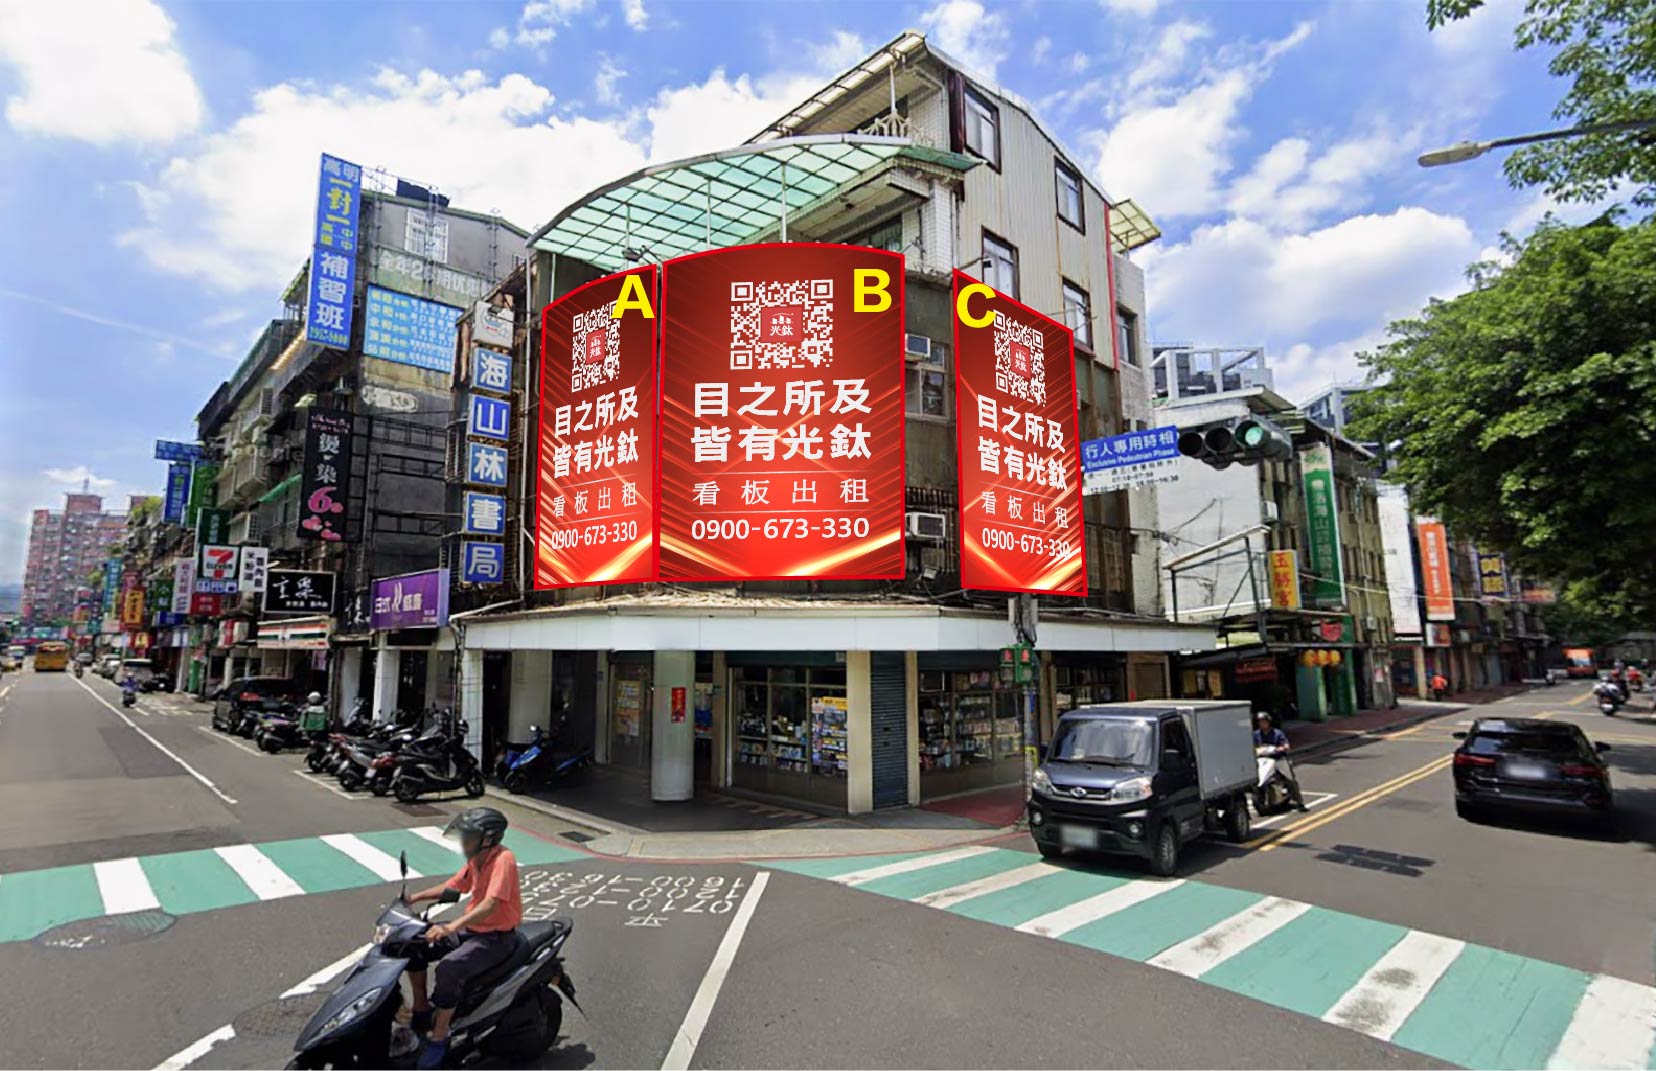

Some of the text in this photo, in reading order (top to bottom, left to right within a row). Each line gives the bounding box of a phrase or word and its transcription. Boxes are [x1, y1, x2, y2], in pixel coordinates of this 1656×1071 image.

[315, 251, 349, 331] 補習班
[553, 386, 640, 439] 目之所及
[694, 378, 872, 418] 目之所及
[690, 422, 872, 463] 皆有光鈦
[977, 393, 1066, 454] 目之所及
[467, 353, 508, 579] 海山林書局
[552, 428, 639, 479] 皆有光鈦
[977, 435, 1068, 492] 皆有光鈦
[552, 482, 638, 518] 看板出租
[692, 477, 870, 506] 看板出租
[981, 490, 1069, 529] 看板出租
[551, 520, 638, 550] 0900-673-330
[691, 517, 870, 540] 0900-673-330
[982, 527, 1071, 561] 0900-673-330
